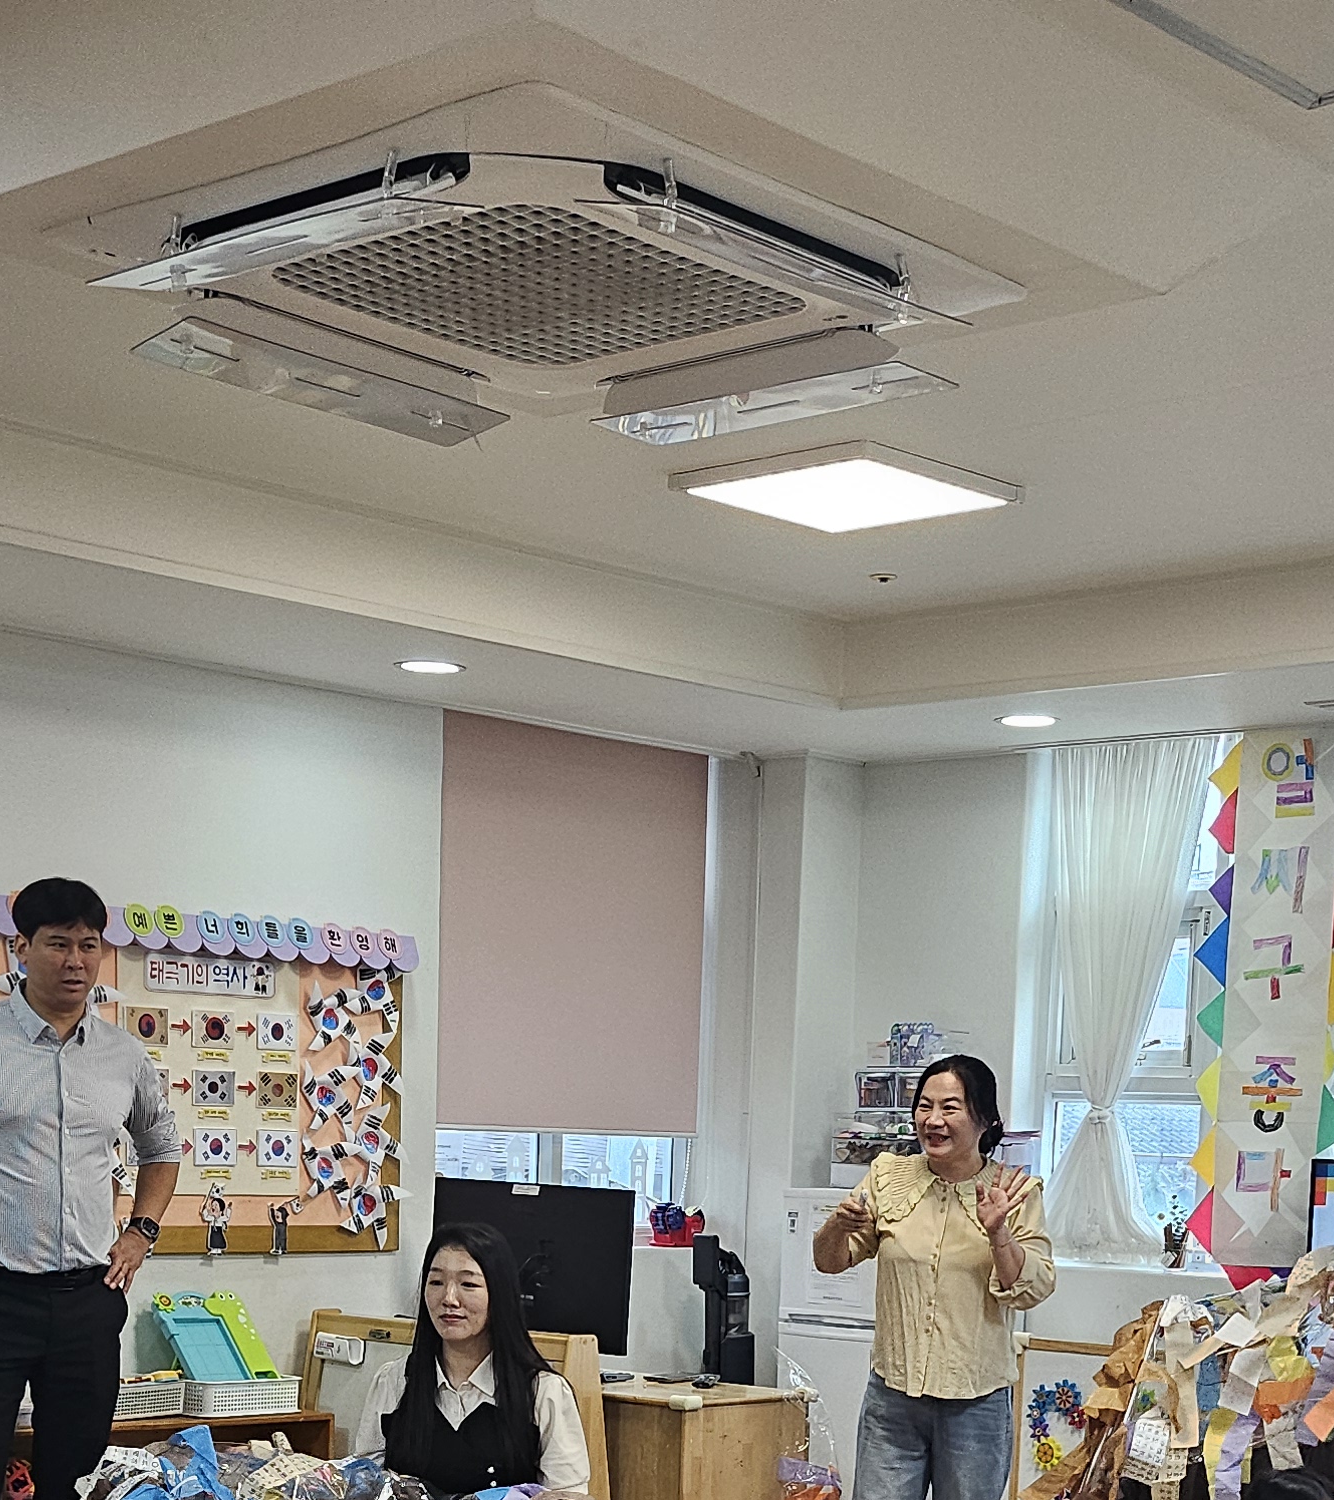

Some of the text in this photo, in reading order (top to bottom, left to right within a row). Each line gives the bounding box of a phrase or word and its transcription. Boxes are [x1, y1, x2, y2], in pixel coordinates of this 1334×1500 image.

[132, 911, 397, 954] 예쁜 너희들을 환영해
[149, 960, 248, 990] 태극기의 역사
